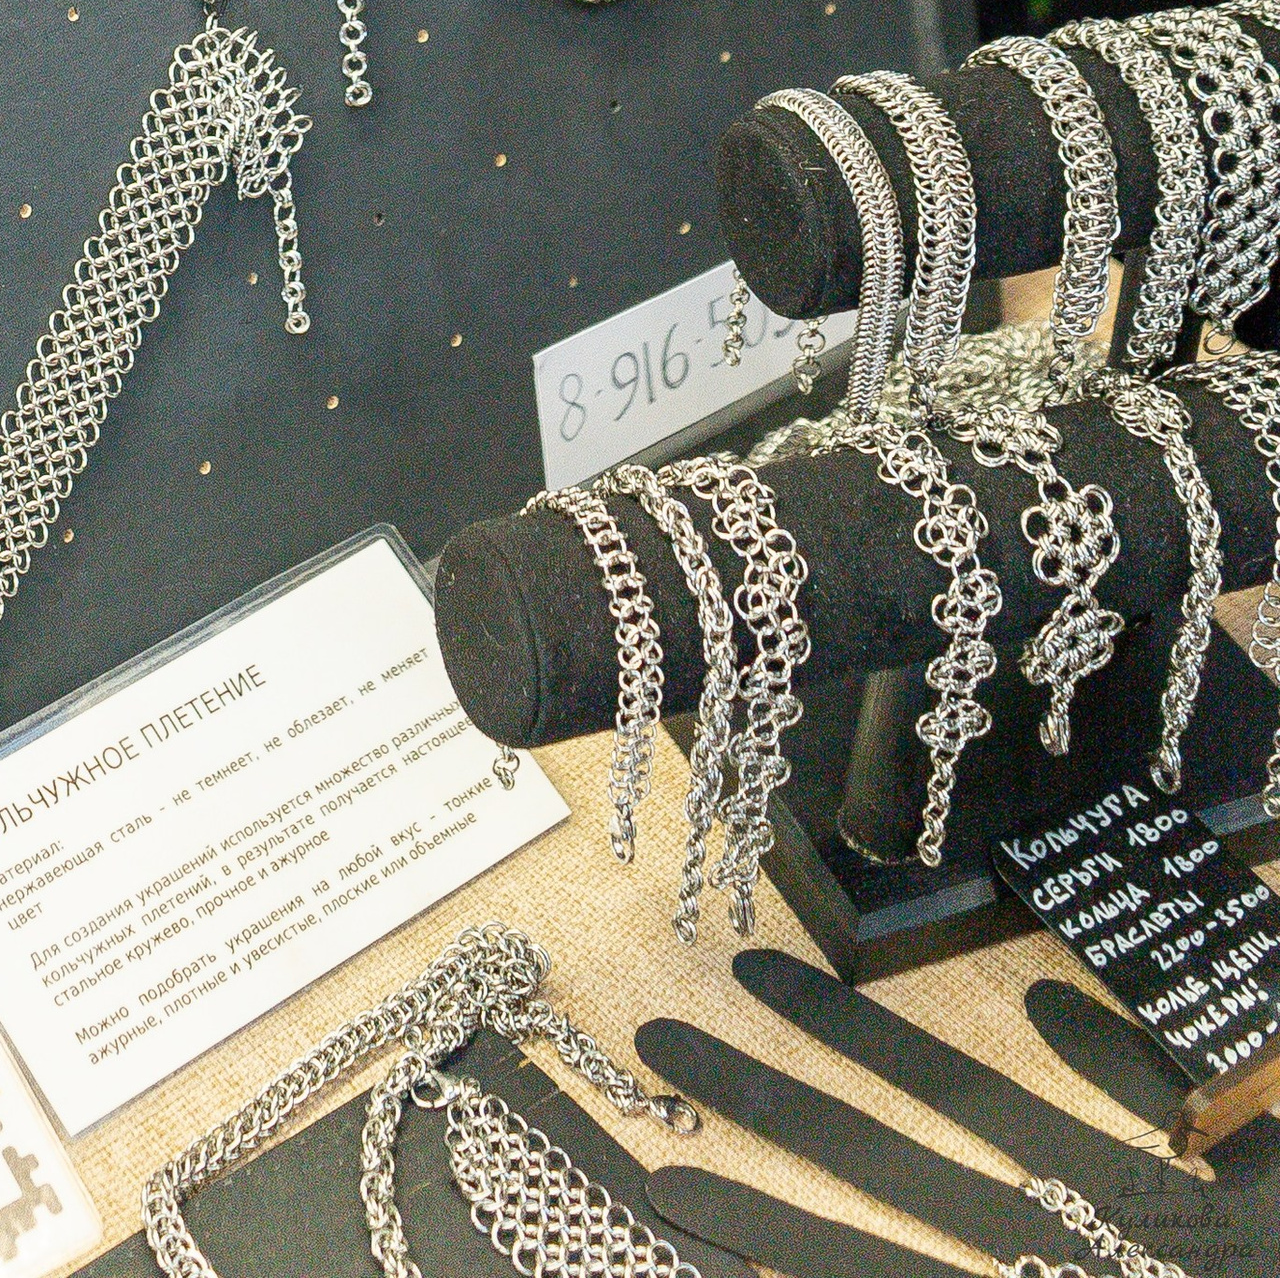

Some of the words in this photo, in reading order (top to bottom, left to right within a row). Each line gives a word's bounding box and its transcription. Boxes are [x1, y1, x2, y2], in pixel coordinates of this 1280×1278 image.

[109, 814, 153, 843] сталь
[171, 788, 192, 806] не
[194, 751, 260, 791] темнеет,
[262, 735, 283, 753] не
[286, 695, 355, 739] облезает,
[356, 679, 377, 696] не
[379, 646, 428, 683] меняет
[138, 663, 267, 748] ПЛЕТЕНИЕ
[29, 942, 61, 971] Для
[62, 898, 134, 947] создания
[134, 844, 218, 907] украшений
[219, 789, 313, 852] используется
[313, 742, 390, 795] множество
[391, 700, 461, 751] различных
[40, 923, 136, 988] кольчужных
[140, 873, 217, 926] плетений,
[220, 864, 232, 876] в
[235, 813, 315, 870] результате
[318, 762, 398, 817] получается
[401, 716, 473, 766] настоящее
[1032, 851, 1123, 911] СЕРЬГИ
[1126, 809, 1188, 847] 1800
[1059, 882, 1151, 940] КОЛЬЦА
[1162, 839, 1219, 879] 1800
[6, 901, 42, 931] цвет
[53, 957, 124, 1007] стальное
[124, 916, 195, 962] кружево,
[194, 874, 257, 919] прочное
[256, 866, 269, 880] и
[268, 829, 330, 873] ажурное
[74, 1005, 129, 1045] Можно
[137, 952, 217, 1006] подобрать
[223, 894, 305, 955] украшения
[310, 879, 330, 897] на
[337, 843, 383, 881] любой
[389, 820, 422, 847] вкус
[442, 776, 493, 812] тонкие
[87, 1014, 163, 1065] ажурные,
[162, 970, 228, 1017] плотные
[228, 961, 241, 975] и
[241, 912, 322, 970] увесистые,
[320, 873, 380, 916] плоские
[379, 855, 409, 878] или
[407, 811, 477, 860] объемные
[1084, 890, 1205, 967] БРАСЛЕТЫ
[1164, 977, 1269, 1049] ЧОКЕРЫ!
